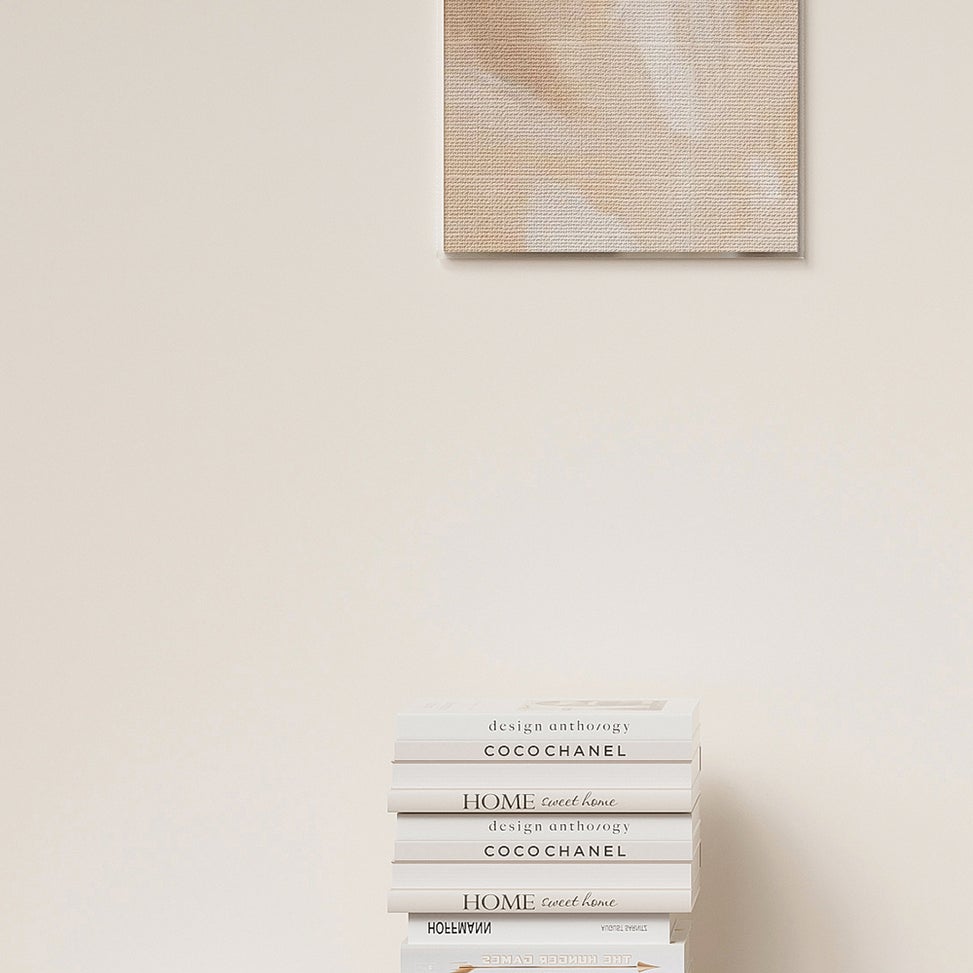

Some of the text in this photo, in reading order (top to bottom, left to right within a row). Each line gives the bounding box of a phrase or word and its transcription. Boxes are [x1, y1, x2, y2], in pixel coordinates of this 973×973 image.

[488, 720, 542, 734] design
[484, 745, 626, 757] COCO CHANEL
[463, 791, 618, 810] HOME sweet home
[488, 820, 542, 834] design
[484, 845, 626, 857] COCO CHANEL
[463, 892, 618, 911] HOME sweet home
